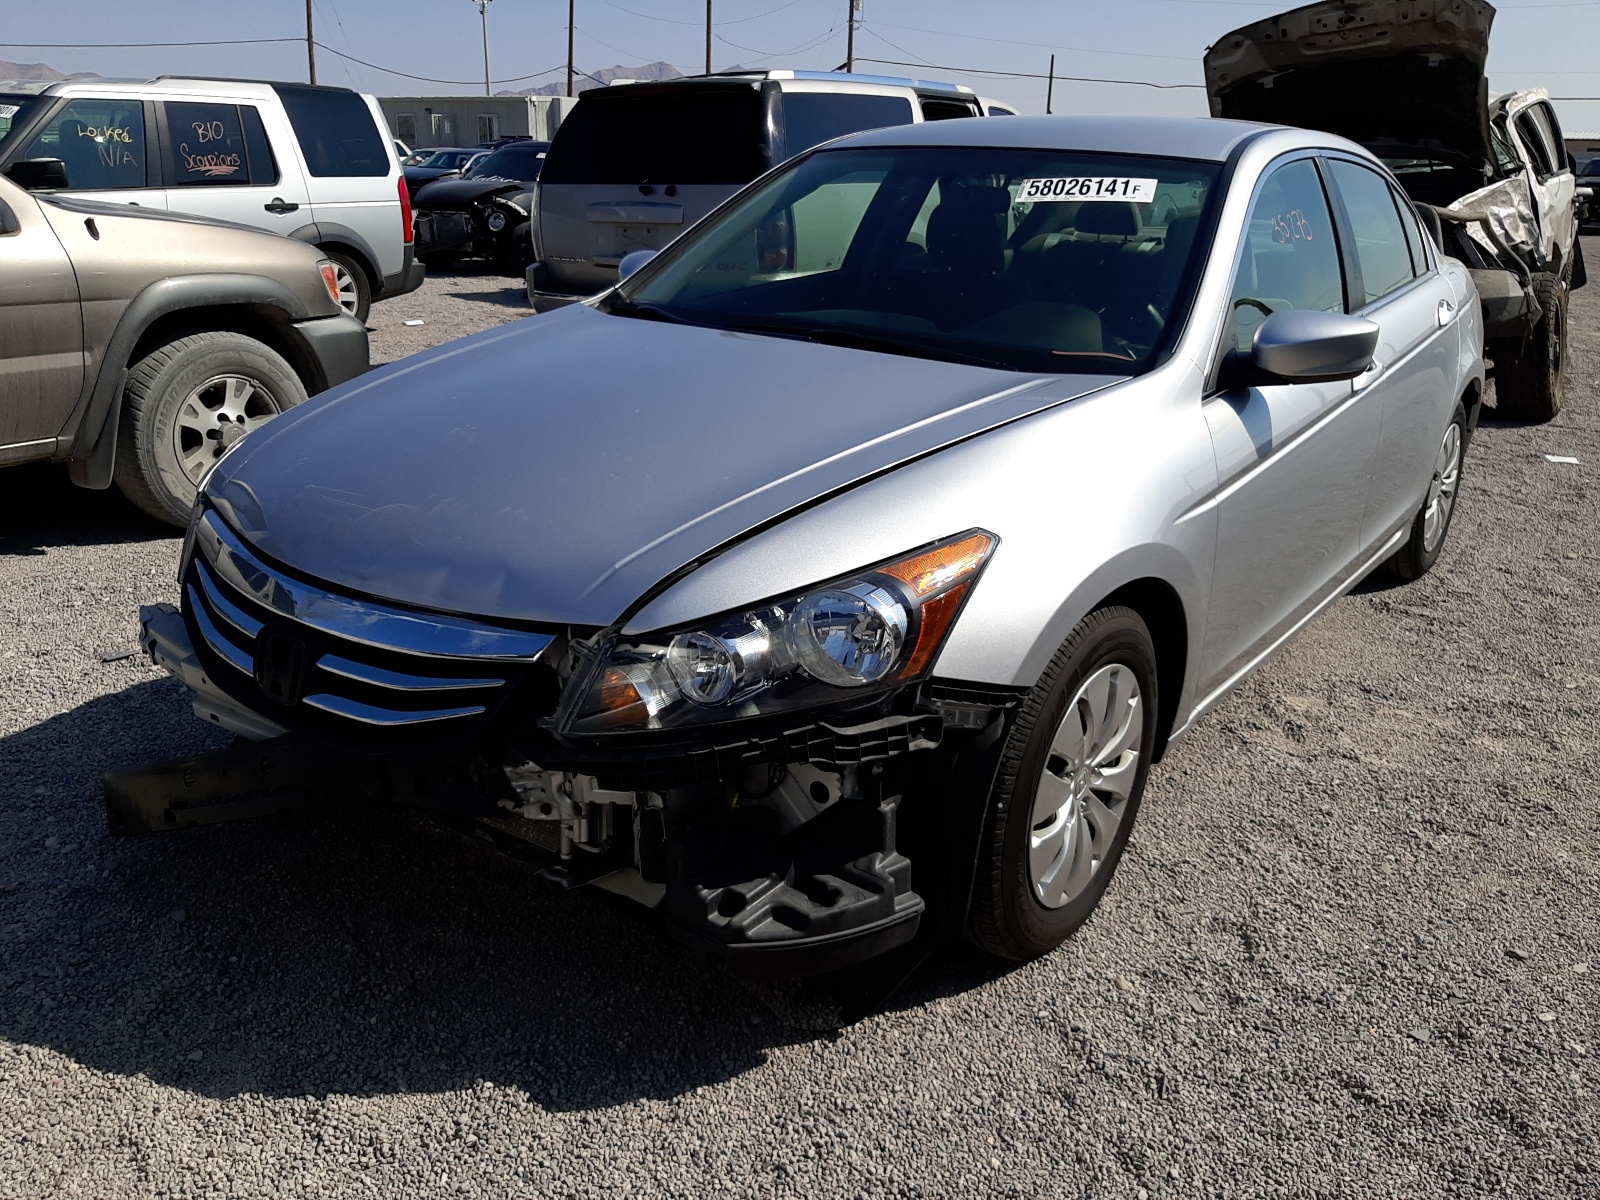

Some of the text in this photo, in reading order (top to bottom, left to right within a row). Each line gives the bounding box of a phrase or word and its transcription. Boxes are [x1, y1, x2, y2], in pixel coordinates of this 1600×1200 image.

[98, 144, 138, 167] N/A
[180, 143, 240, 169] Scorpions
[1027, 178, 1130, 196] 58026141
[1132, 183, 1142, 195] F
